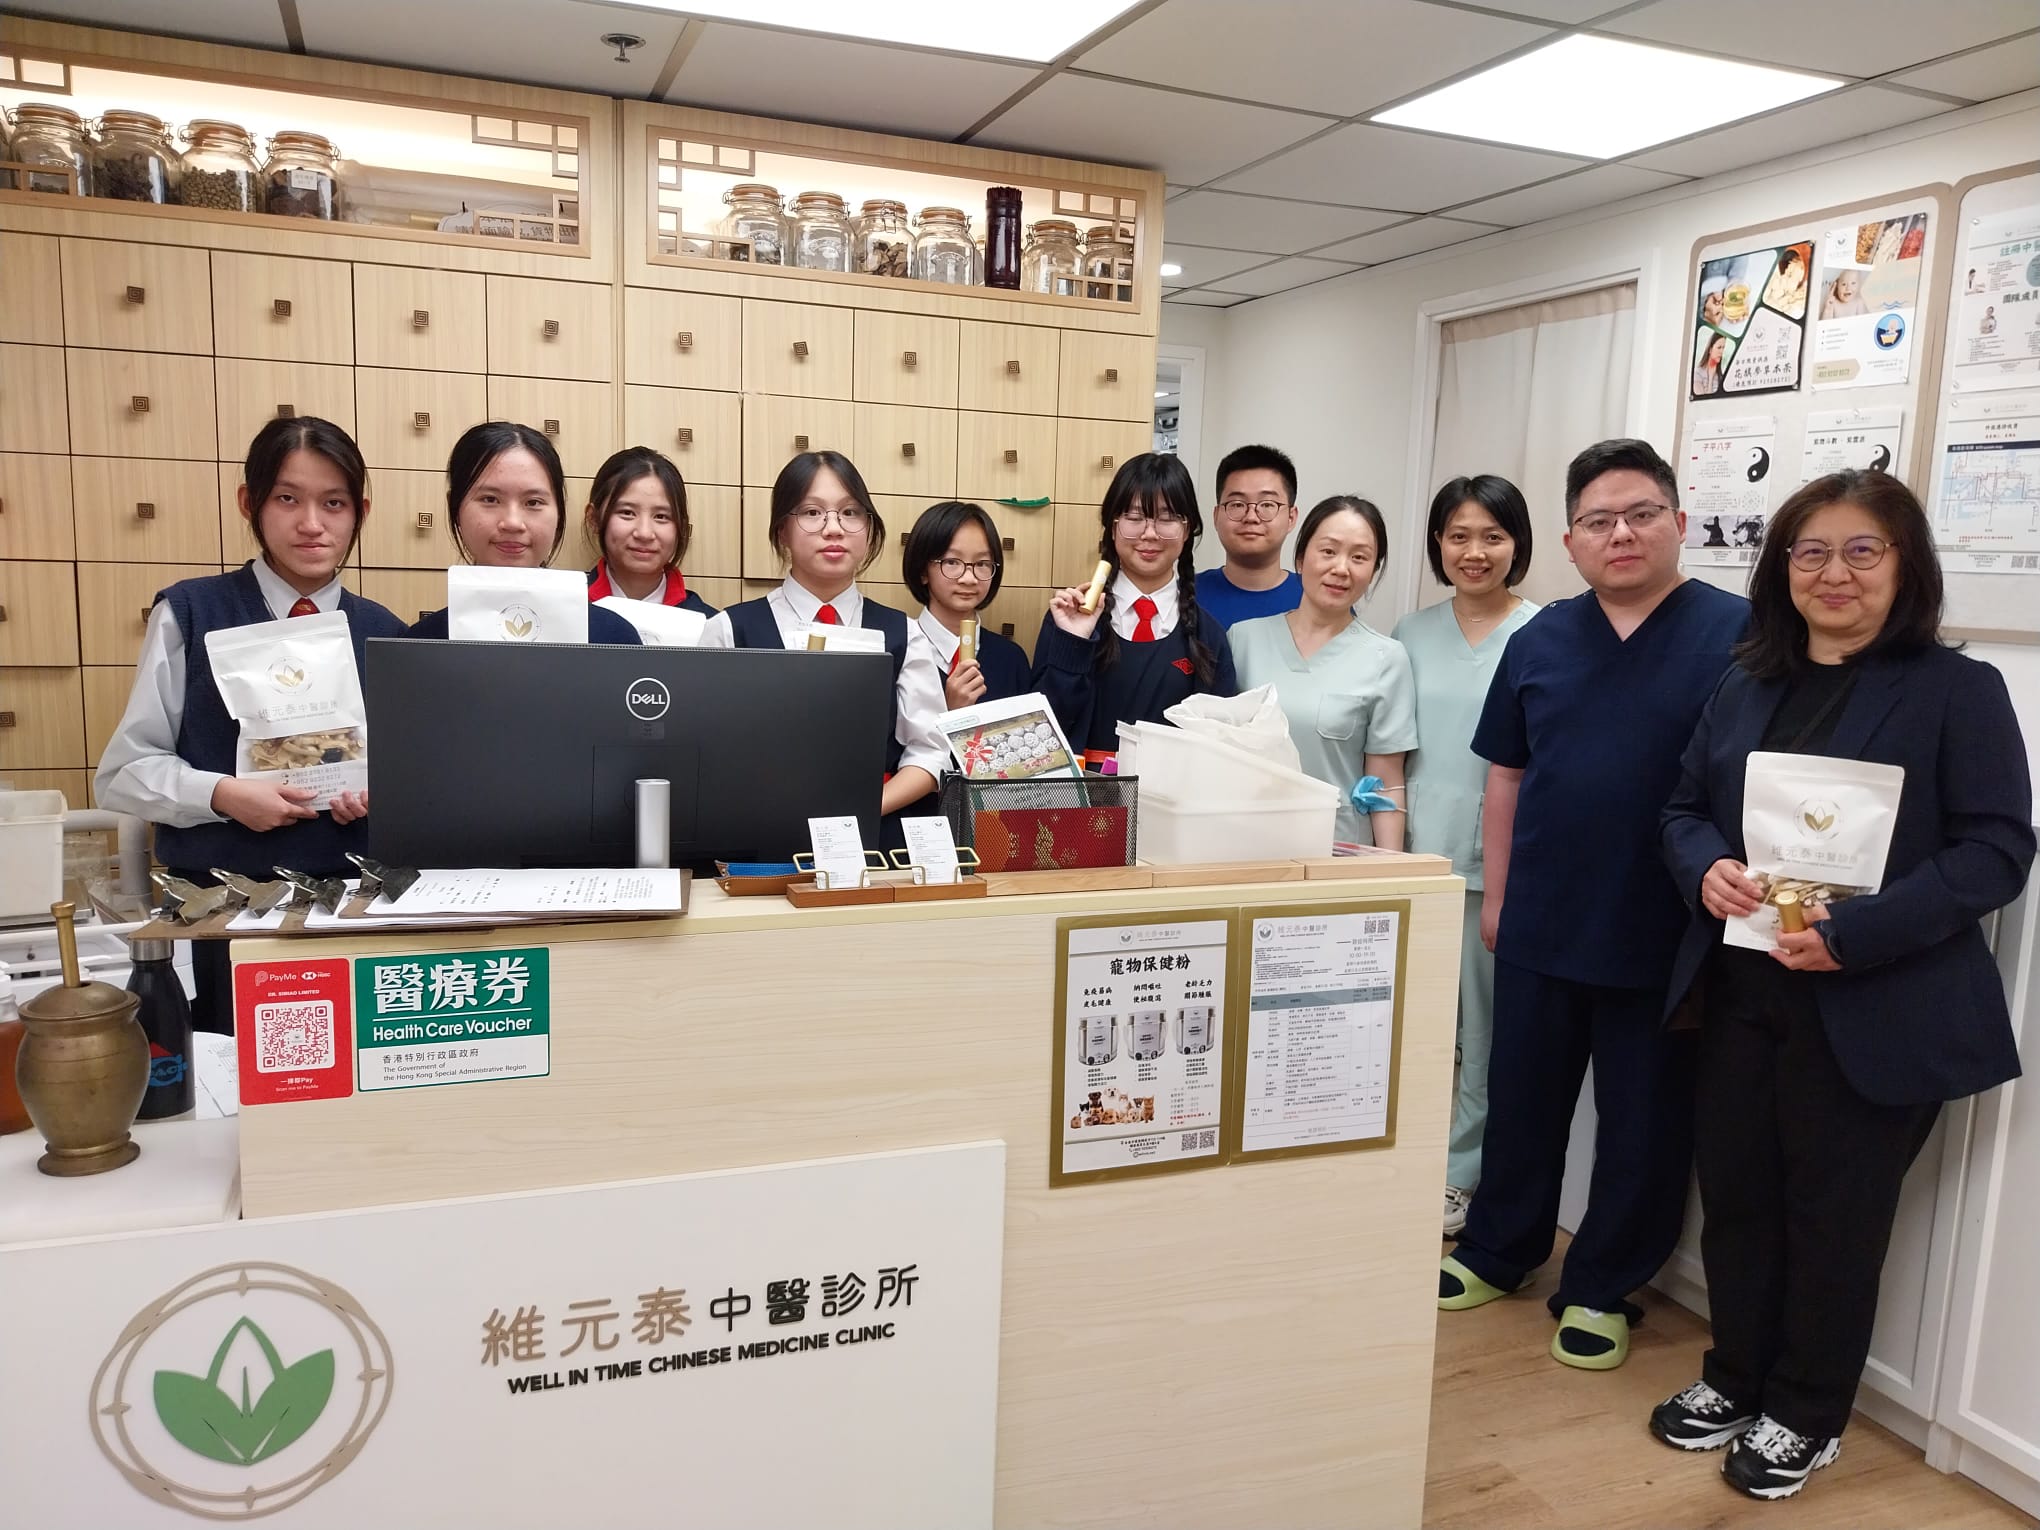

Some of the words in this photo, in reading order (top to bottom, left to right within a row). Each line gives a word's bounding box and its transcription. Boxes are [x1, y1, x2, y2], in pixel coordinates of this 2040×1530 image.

[632, 693, 666, 705] DELL
[1109, 953, 1191, 976] 寵物保健粉
[374, 957, 530, 1014] 醫療券
[373, 1023, 424, 1041] Health
[426, 1022, 464, 1038] Care
[465, 1017, 532, 1034] Voucher
[383, 1048, 479, 1064] 香港特別行政區政府
[396, 1073, 414, 1081] Hong
[416, 1072, 433, 1080] Kong
[435, 1069, 457, 1078] Special
[459, 1066, 504, 1076] Administrative
[505, 1063, 527, 1073] Region
[397, 1064, 437, 1072] Government
[481, 1263, 919, 1366] 維元泰中醫診所
[508, 1371, 565, 1394] WELL
[567, 1367, 589, 1386] IN
[594, 1360, 642, 1383] TIME
[648, 1346, 732, 1373] CHINESE
[738, 1333, 830, 1361] MEDICINE
[835, 1322, 896, 1347] CLINIC
